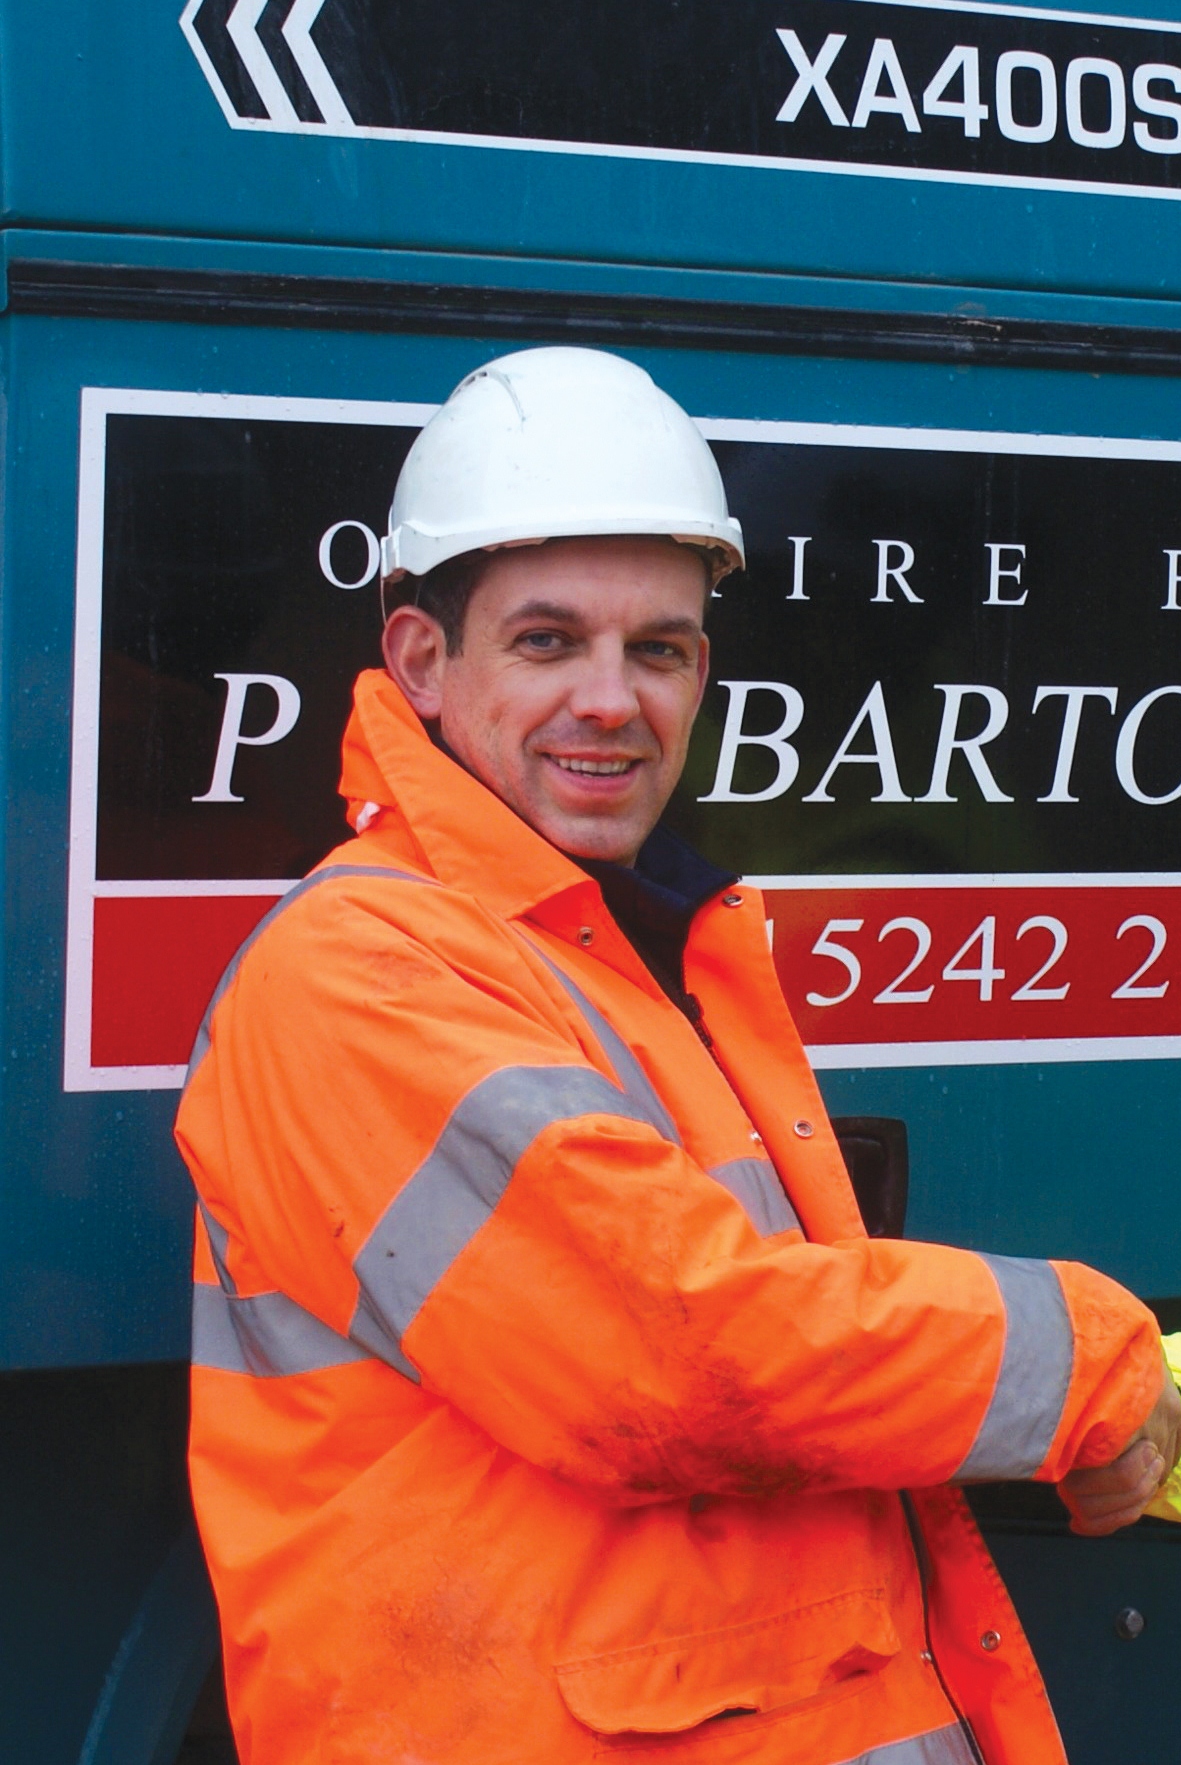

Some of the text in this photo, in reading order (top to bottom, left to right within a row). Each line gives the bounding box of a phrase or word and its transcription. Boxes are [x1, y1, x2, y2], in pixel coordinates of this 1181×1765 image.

[318, 520, 380, 590] O
[711, 536, 1029, 606] IRE
[191, 673, 301, 802] P
[765, 915, 1071, 1007] 5242
